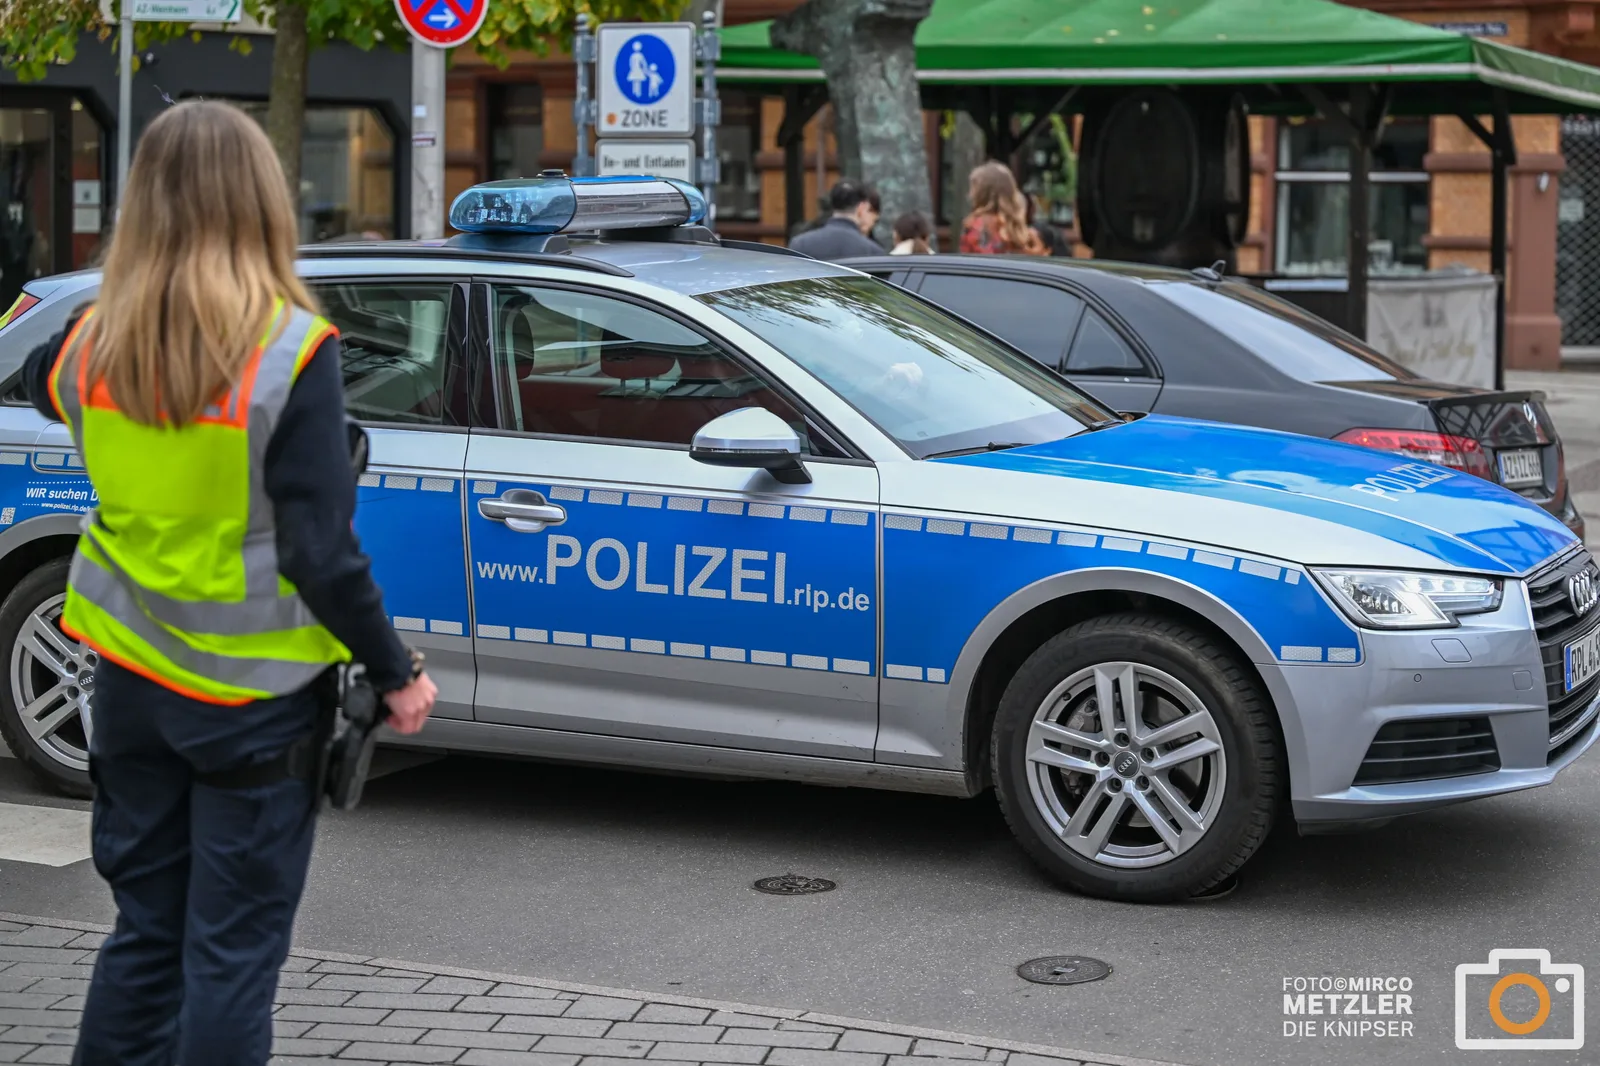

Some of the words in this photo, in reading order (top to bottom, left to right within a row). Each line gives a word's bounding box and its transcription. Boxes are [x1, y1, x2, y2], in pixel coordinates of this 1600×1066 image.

[621, 109, 668, 127] ZONE
[623, 155, 640, 168] und
[644, 155, 685, 168] Entladen
[1350, 462, 1457, 501] POLIZEI
[26, 487, 47, 499] WIR
[48, 488, 88, 501] suchen
